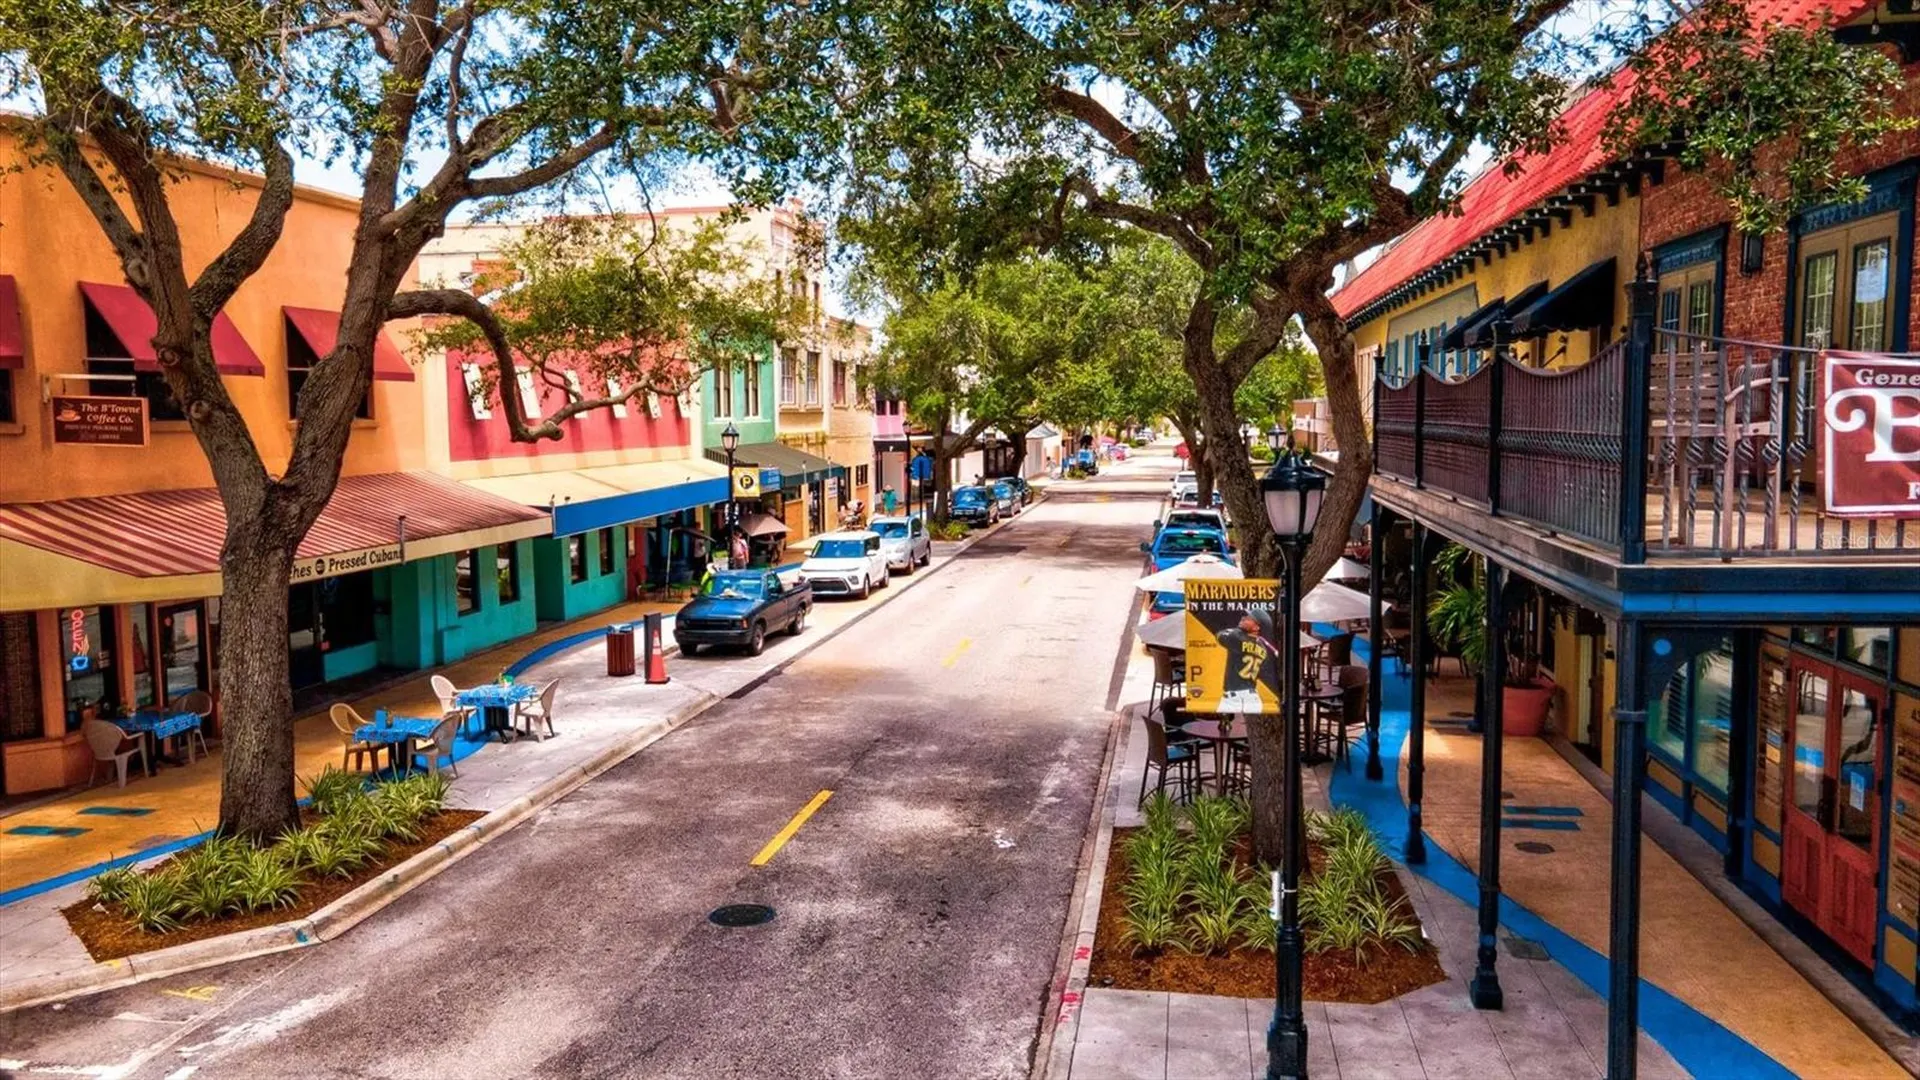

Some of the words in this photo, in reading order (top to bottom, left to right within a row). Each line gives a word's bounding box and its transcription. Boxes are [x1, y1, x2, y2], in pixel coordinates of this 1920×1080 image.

[81, 403, 98, 413] The
[86, 413, 117, 424] Coffee
[118, 414, 134, 423] Co.
[328, 552, 367, 572] Pressed
[1187, 583, 1276, 600] MARAUDERS
[1187, 602, 1199, 611] IN
[1201, 602, 1224, 611] THE
[1227, 602, 1276, 611] MAJORS
[71, 609, 85, 653] OPEN
[1190, 665, 1203, 682] P
